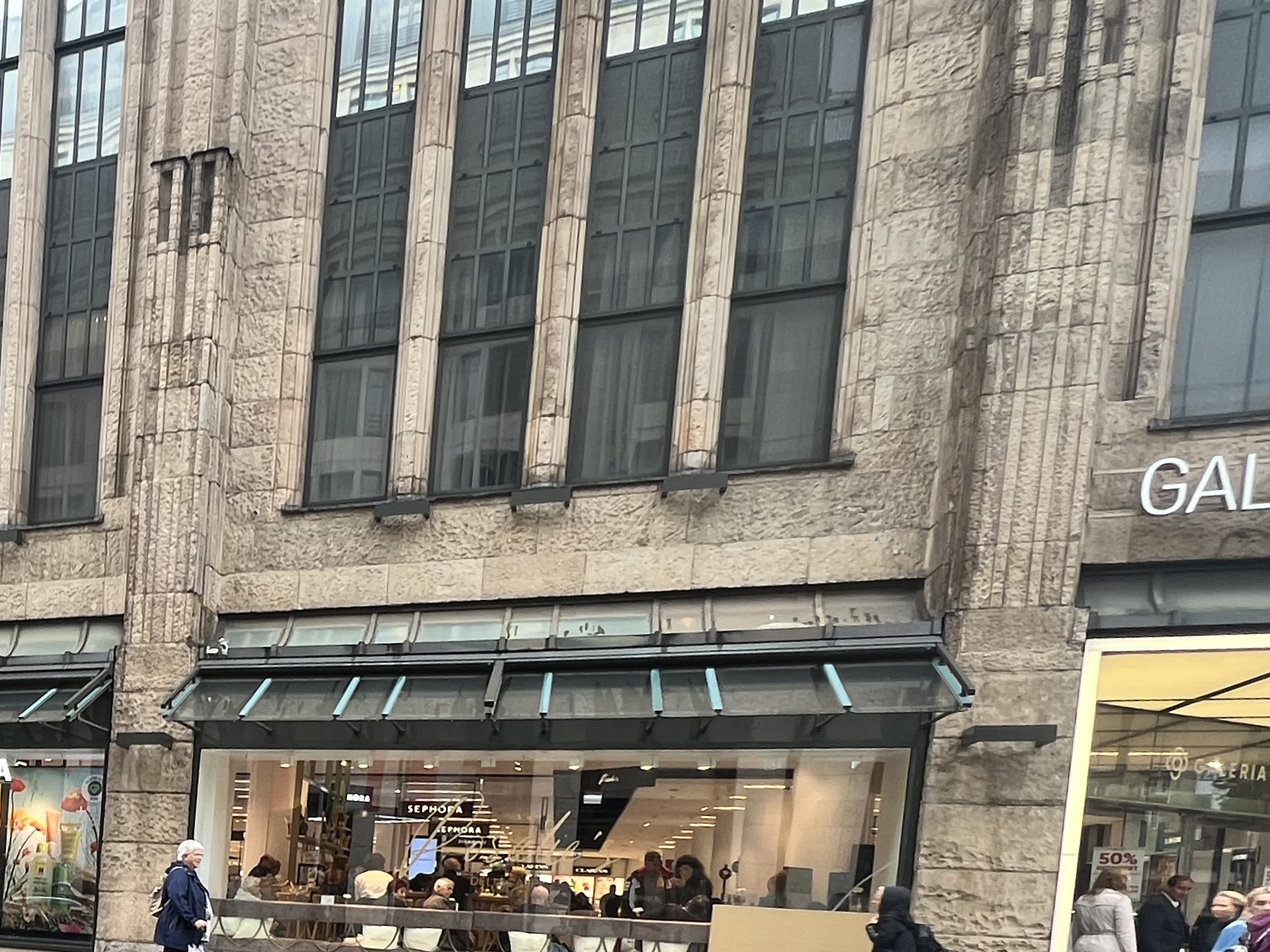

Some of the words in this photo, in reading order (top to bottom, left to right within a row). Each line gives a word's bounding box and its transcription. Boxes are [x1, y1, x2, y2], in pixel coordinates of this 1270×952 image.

[1140, 453, 1270, 516] GAL
[407, 804, 463, 815] SEPHORA
[1098, 852, 1138, 865] 50%
